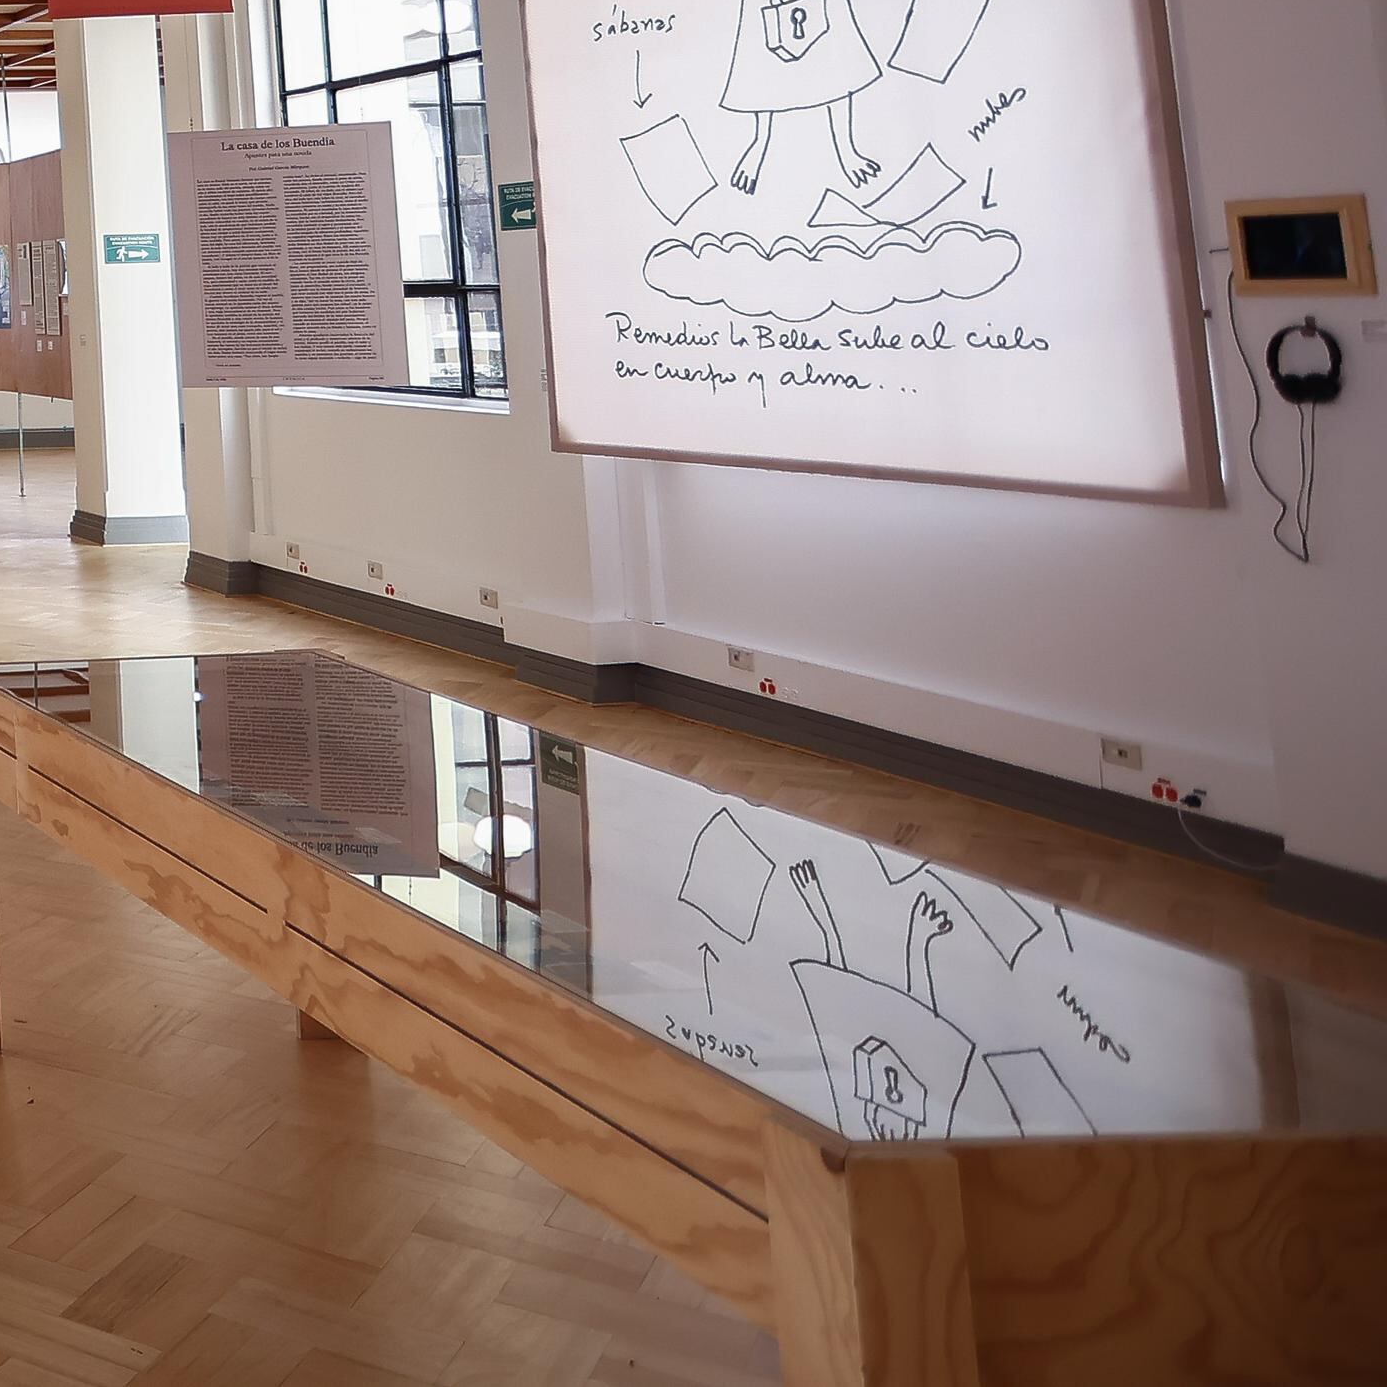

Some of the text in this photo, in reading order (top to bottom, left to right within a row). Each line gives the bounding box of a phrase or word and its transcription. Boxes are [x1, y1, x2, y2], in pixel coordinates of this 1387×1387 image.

[593, 4, 676, 42] sábanas
[221, 141, 235, 151] La
[236, 143, 258, 151] casa
[260, 139, 274, 150] de
[275, 139, 290, 149] los
[605, 311, 720, 347] Remedios
[752, 324, 832, 351] Bella
[910, 322, 956, 351] al
[966, 322, 1050, 352] cielo
[615, 359, 648, 378] en
[654, 360, 738, 394] cuerpo
[748, 369, 766, 408] y
